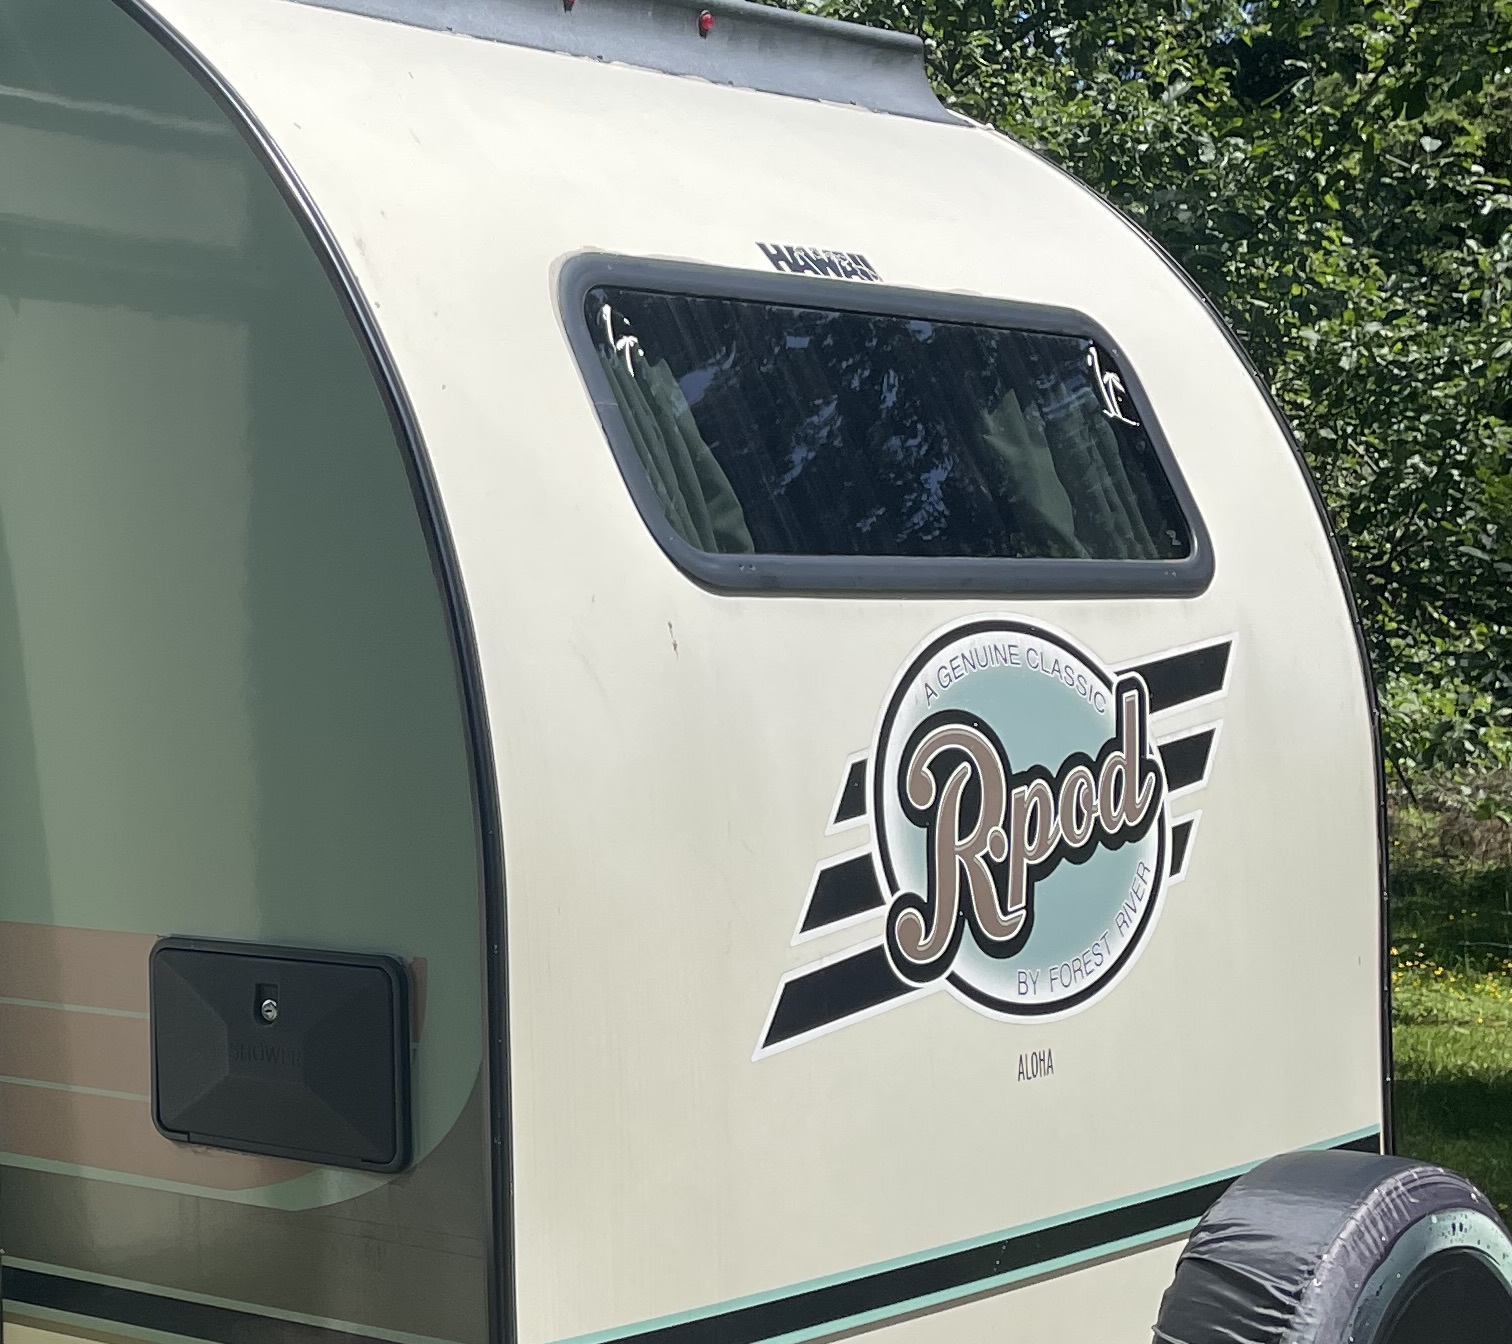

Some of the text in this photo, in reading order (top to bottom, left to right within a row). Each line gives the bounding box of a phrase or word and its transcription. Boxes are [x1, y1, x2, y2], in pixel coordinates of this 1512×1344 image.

[923, 644, 1109, 714] A GENUINE CLASSIC
[1017, 861, 1152, 996] BY FOREST RIVER
[1017, 1047, 1055, 1082] ALOHA
